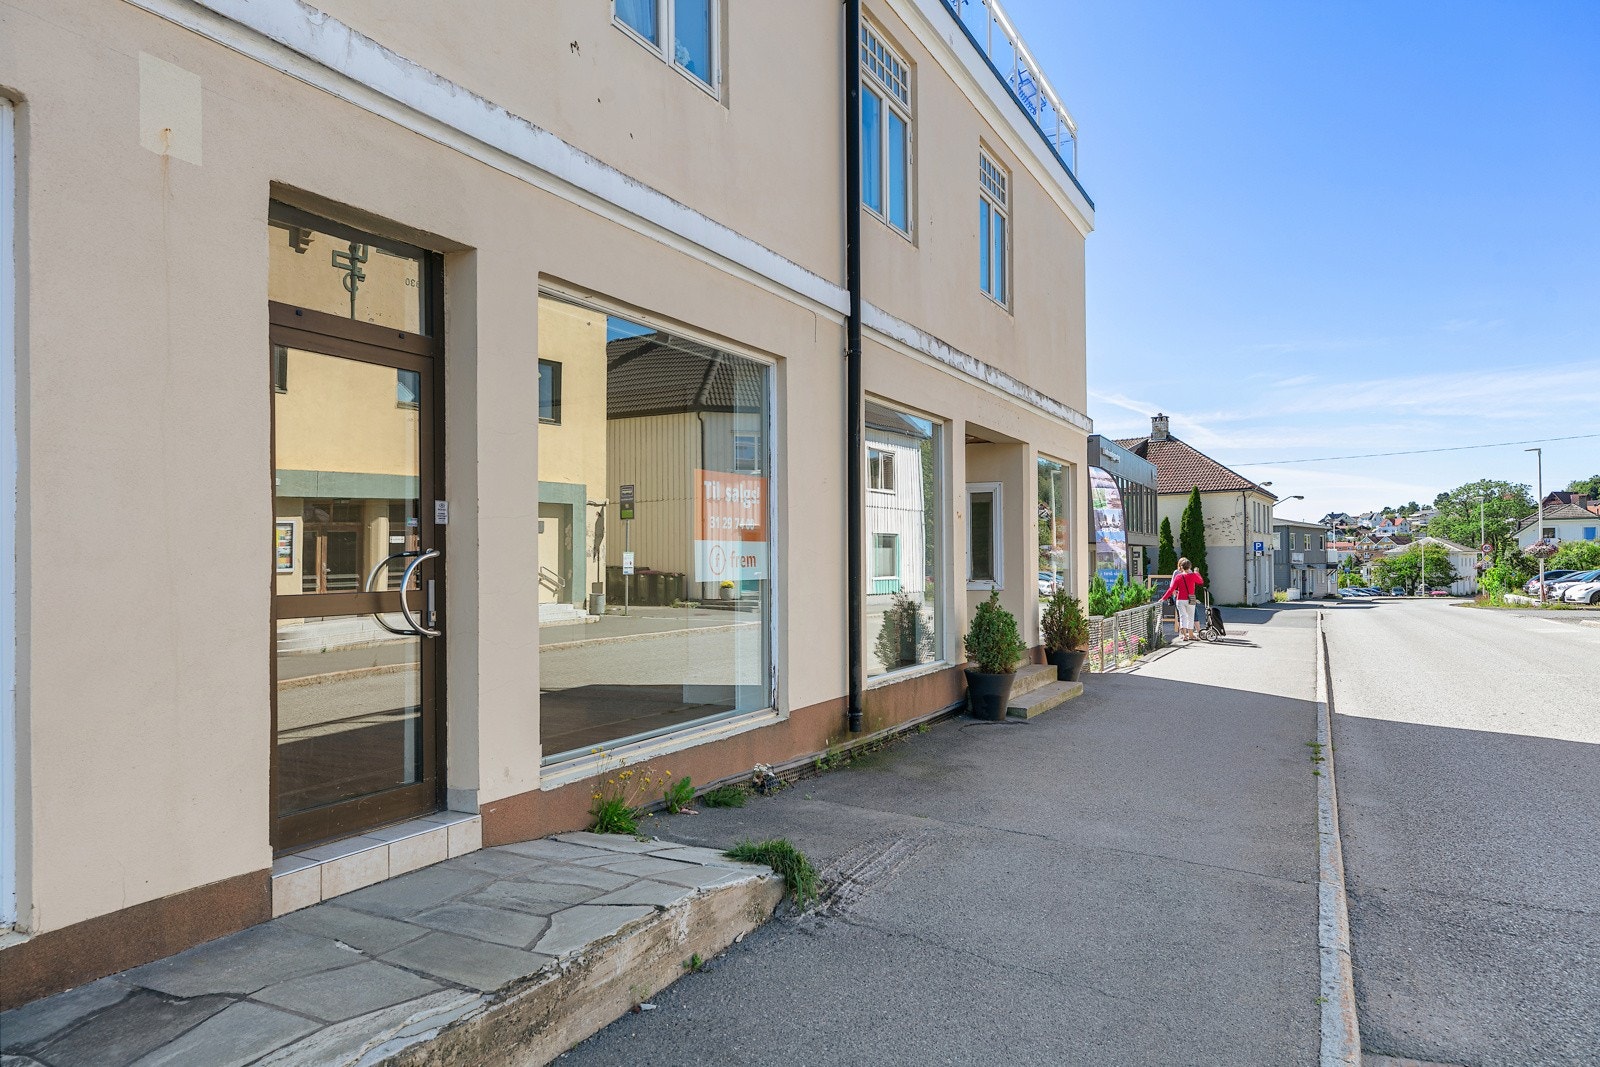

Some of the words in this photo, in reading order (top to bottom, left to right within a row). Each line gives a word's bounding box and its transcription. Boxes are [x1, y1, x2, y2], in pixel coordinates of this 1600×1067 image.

[704, 481, 720, 500] Til
[1255, 542, 1262, 550] P
[729, 549, 757, 568] frem
